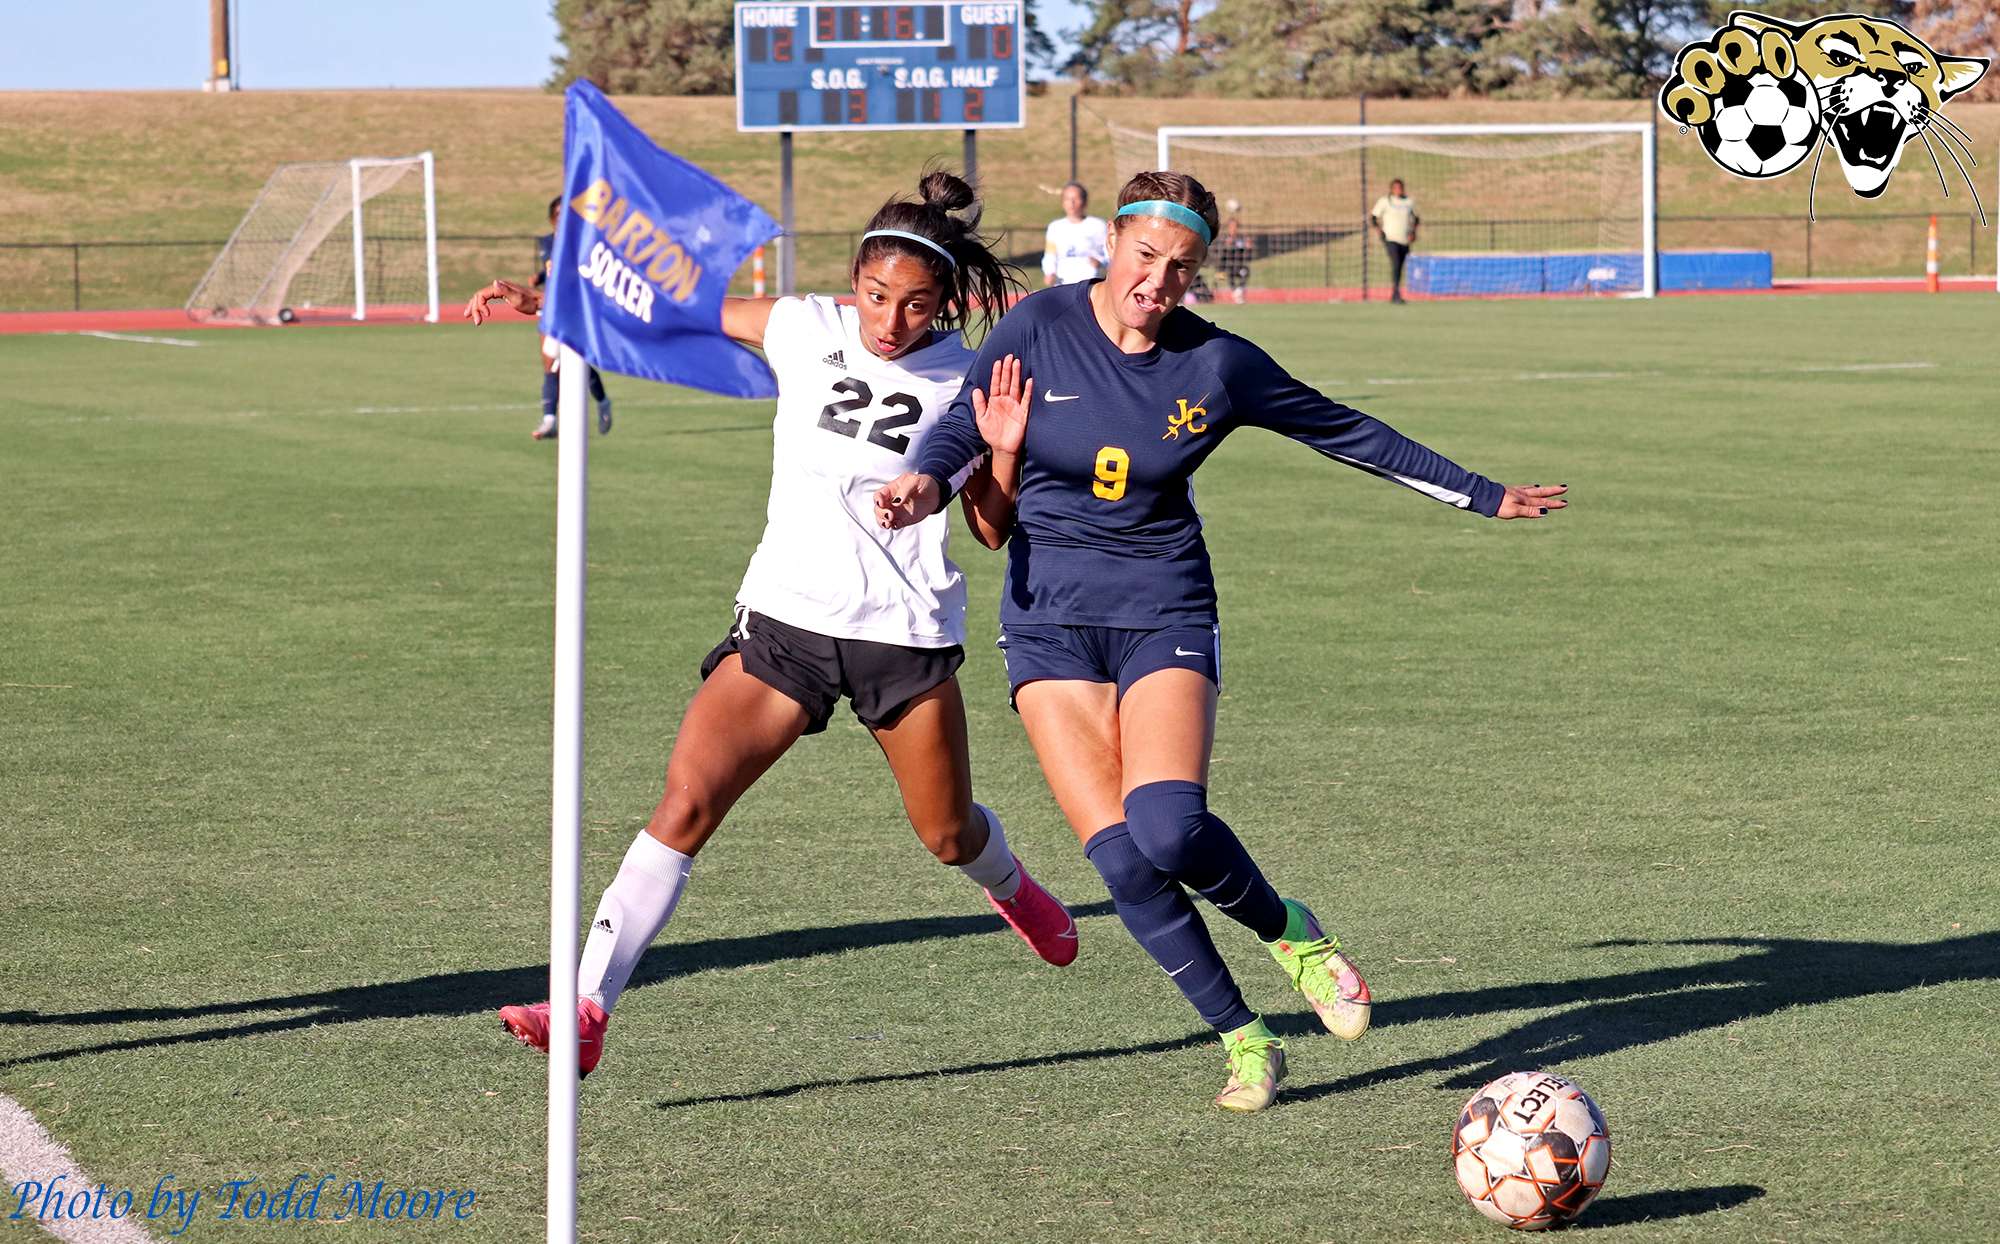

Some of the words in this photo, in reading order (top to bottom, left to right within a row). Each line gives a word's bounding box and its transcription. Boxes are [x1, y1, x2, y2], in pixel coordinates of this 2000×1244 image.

[742, 7, 798, 27] HOME
[961, 5, 1016, 25] GUEST
[773, 28, 793, 62] 2
[992, 25, 1012, 59] 0
[811, 68, 866, 90] S.O.G.
[894, 67, 948, 89] S.O.G.
[951, 66, 999, 88] HALF
[848, 90, 867, 123] 3
[964, 88, 984, 122] 2
[570, 178, 703, 303] BARTON
[578, 242, 656, 324] SOCCER
[822, 357, 848, 371] adidas
[817, 376, 924, 456] 22
[1167, 398, 1208, 434] JC
[1092, 446, 1130, 502] 9
